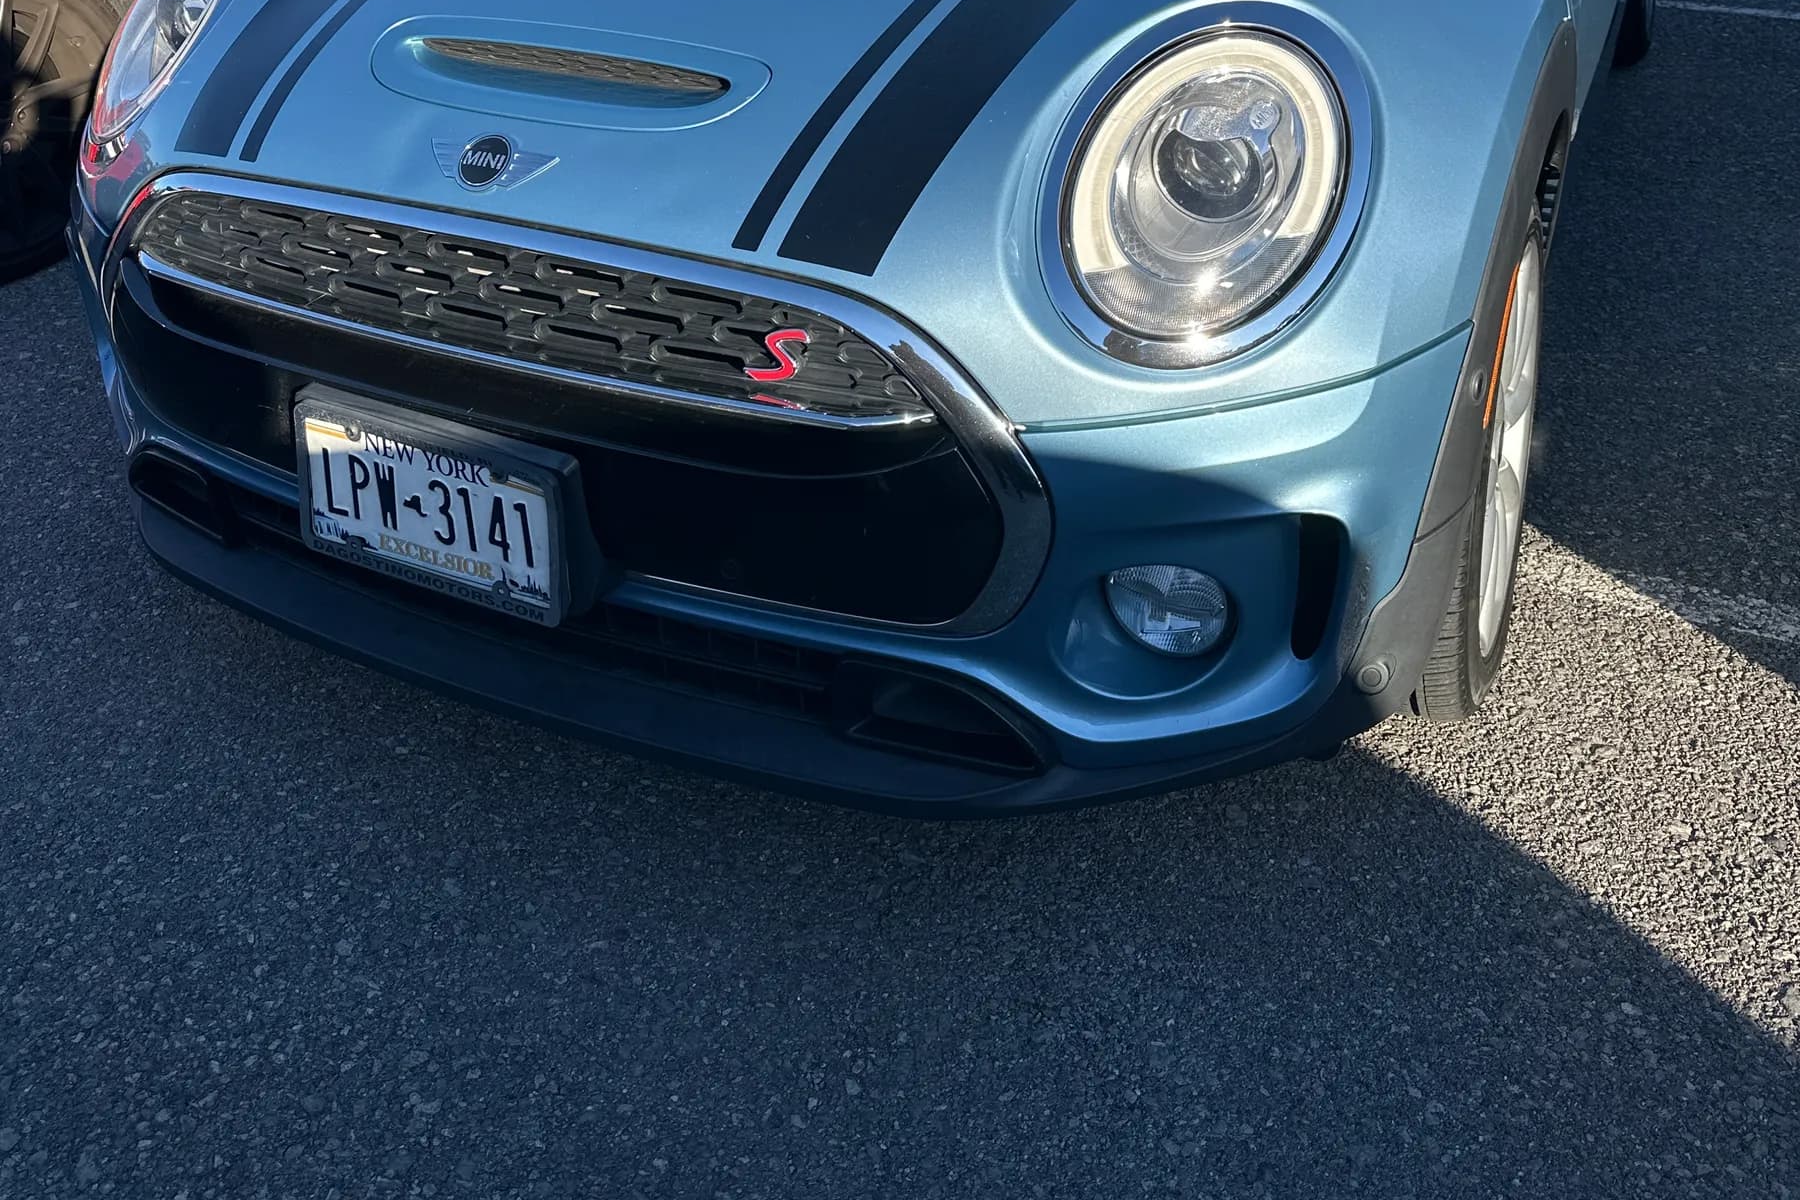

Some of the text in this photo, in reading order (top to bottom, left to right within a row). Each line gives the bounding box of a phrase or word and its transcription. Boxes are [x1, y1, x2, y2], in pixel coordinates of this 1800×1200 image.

[463, 150, 506, 170] MINI
[743, 328, 811, 382] S
[364, 431, 417, 465] NEW
[423, 449, 489, 488] YORK
[321, 447, 399, 531] LPW
[428, 479, 535, 569] 3141
[312, 539, 546, 623] DAGOSTINOMOTORS.COM
[379, 532, 496, 581] EXCELSIOR
